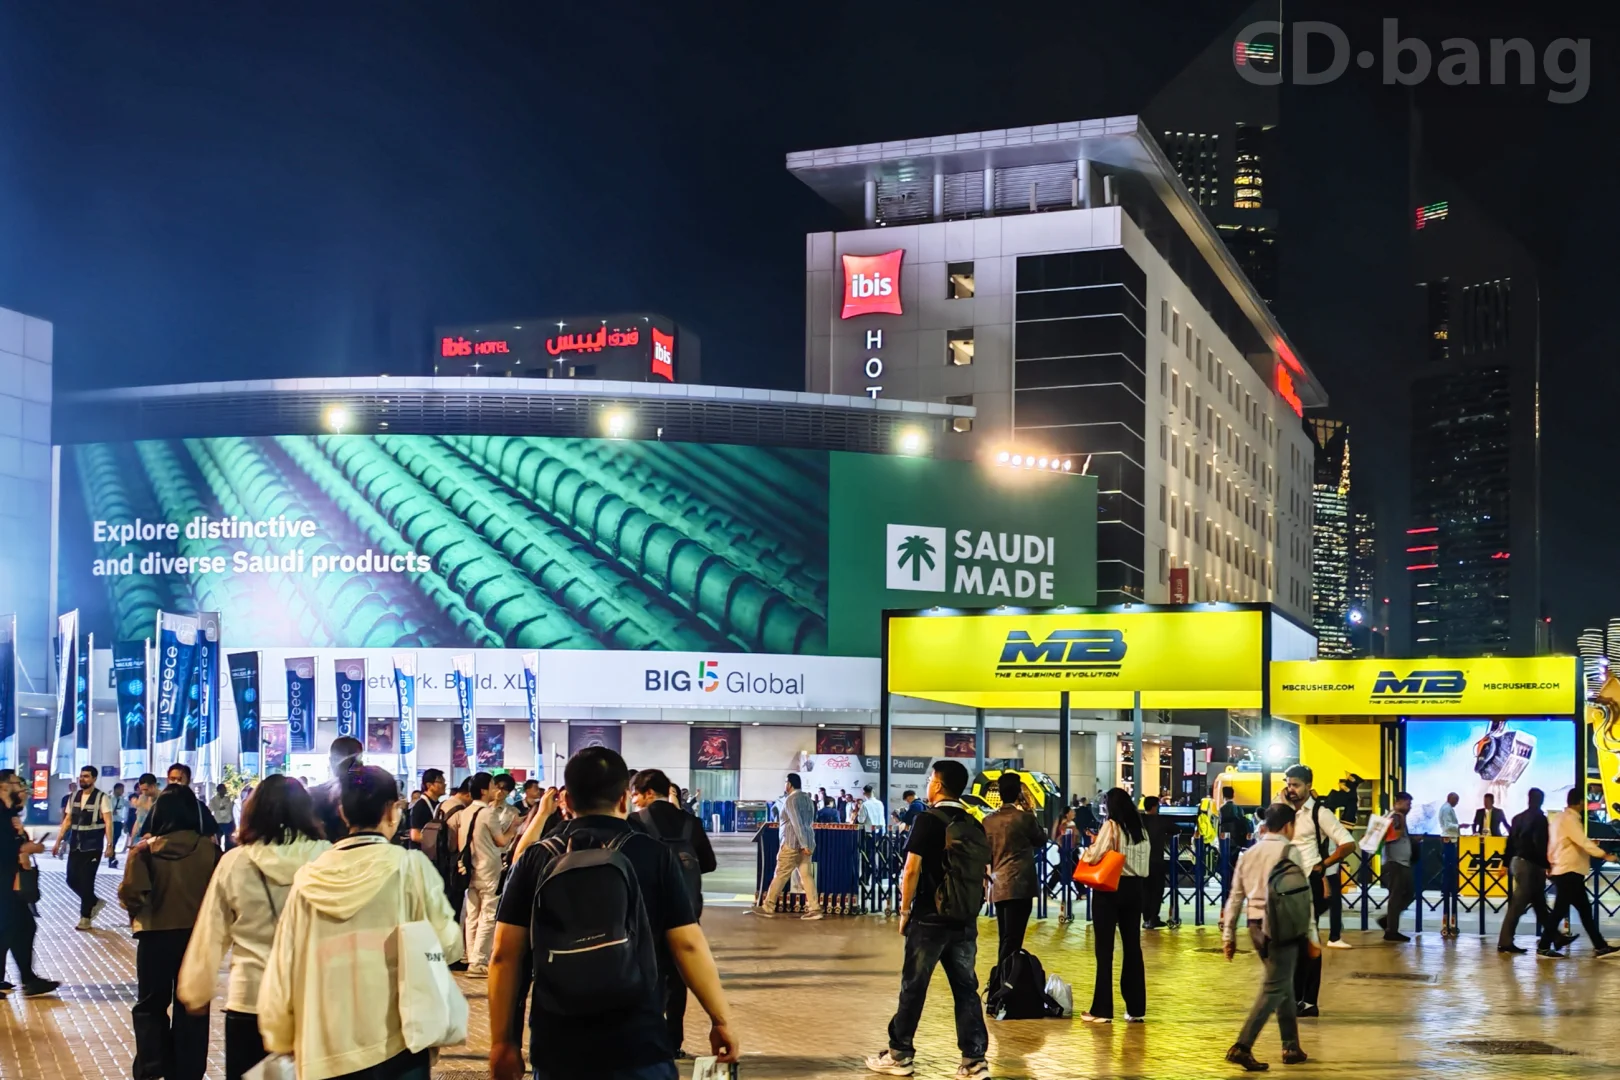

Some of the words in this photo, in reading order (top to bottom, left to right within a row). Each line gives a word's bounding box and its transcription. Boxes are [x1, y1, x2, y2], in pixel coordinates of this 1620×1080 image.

[851, 272, 892, 298] ibis
[442, 336, 472, 357] ibis
[474, 341, 510, 355] HOTEL
[654, 341, 671, 365] ibis
[93, 519, 179, 546] Explore
[185, 515, 316, 540] distinctive
[954, 529, 1054, 565] SAUDI
[92, 552, 133, 576] and
[139, 551, 226, 576] diverse
[232, 550, 304, 575] Saudi
[311, 549, 432, 577] products
[953, 564, 1054, 600] MADE
[999, 629, 1128, 663] MB
[159, 645, 178, 714] Greece
[645, 669, 692, 692] BIG
[698, 660, 719, 692] 5
[726, 671, 804, 695] Global
[1282, 684, 1355, 692] MBCRUSHER.COM
[1372, 670, 1467, 693] MB
[1483, 682, 1560, 691] MBCRUSHER.COM
[290, 681, 302, 733] Greece
[339, 683, 352, 735] Greece
[399, 679, 409, 732] Greece
[866, 758, 881, 769] Egy
[893, 759, 924, 769] Pavilion
